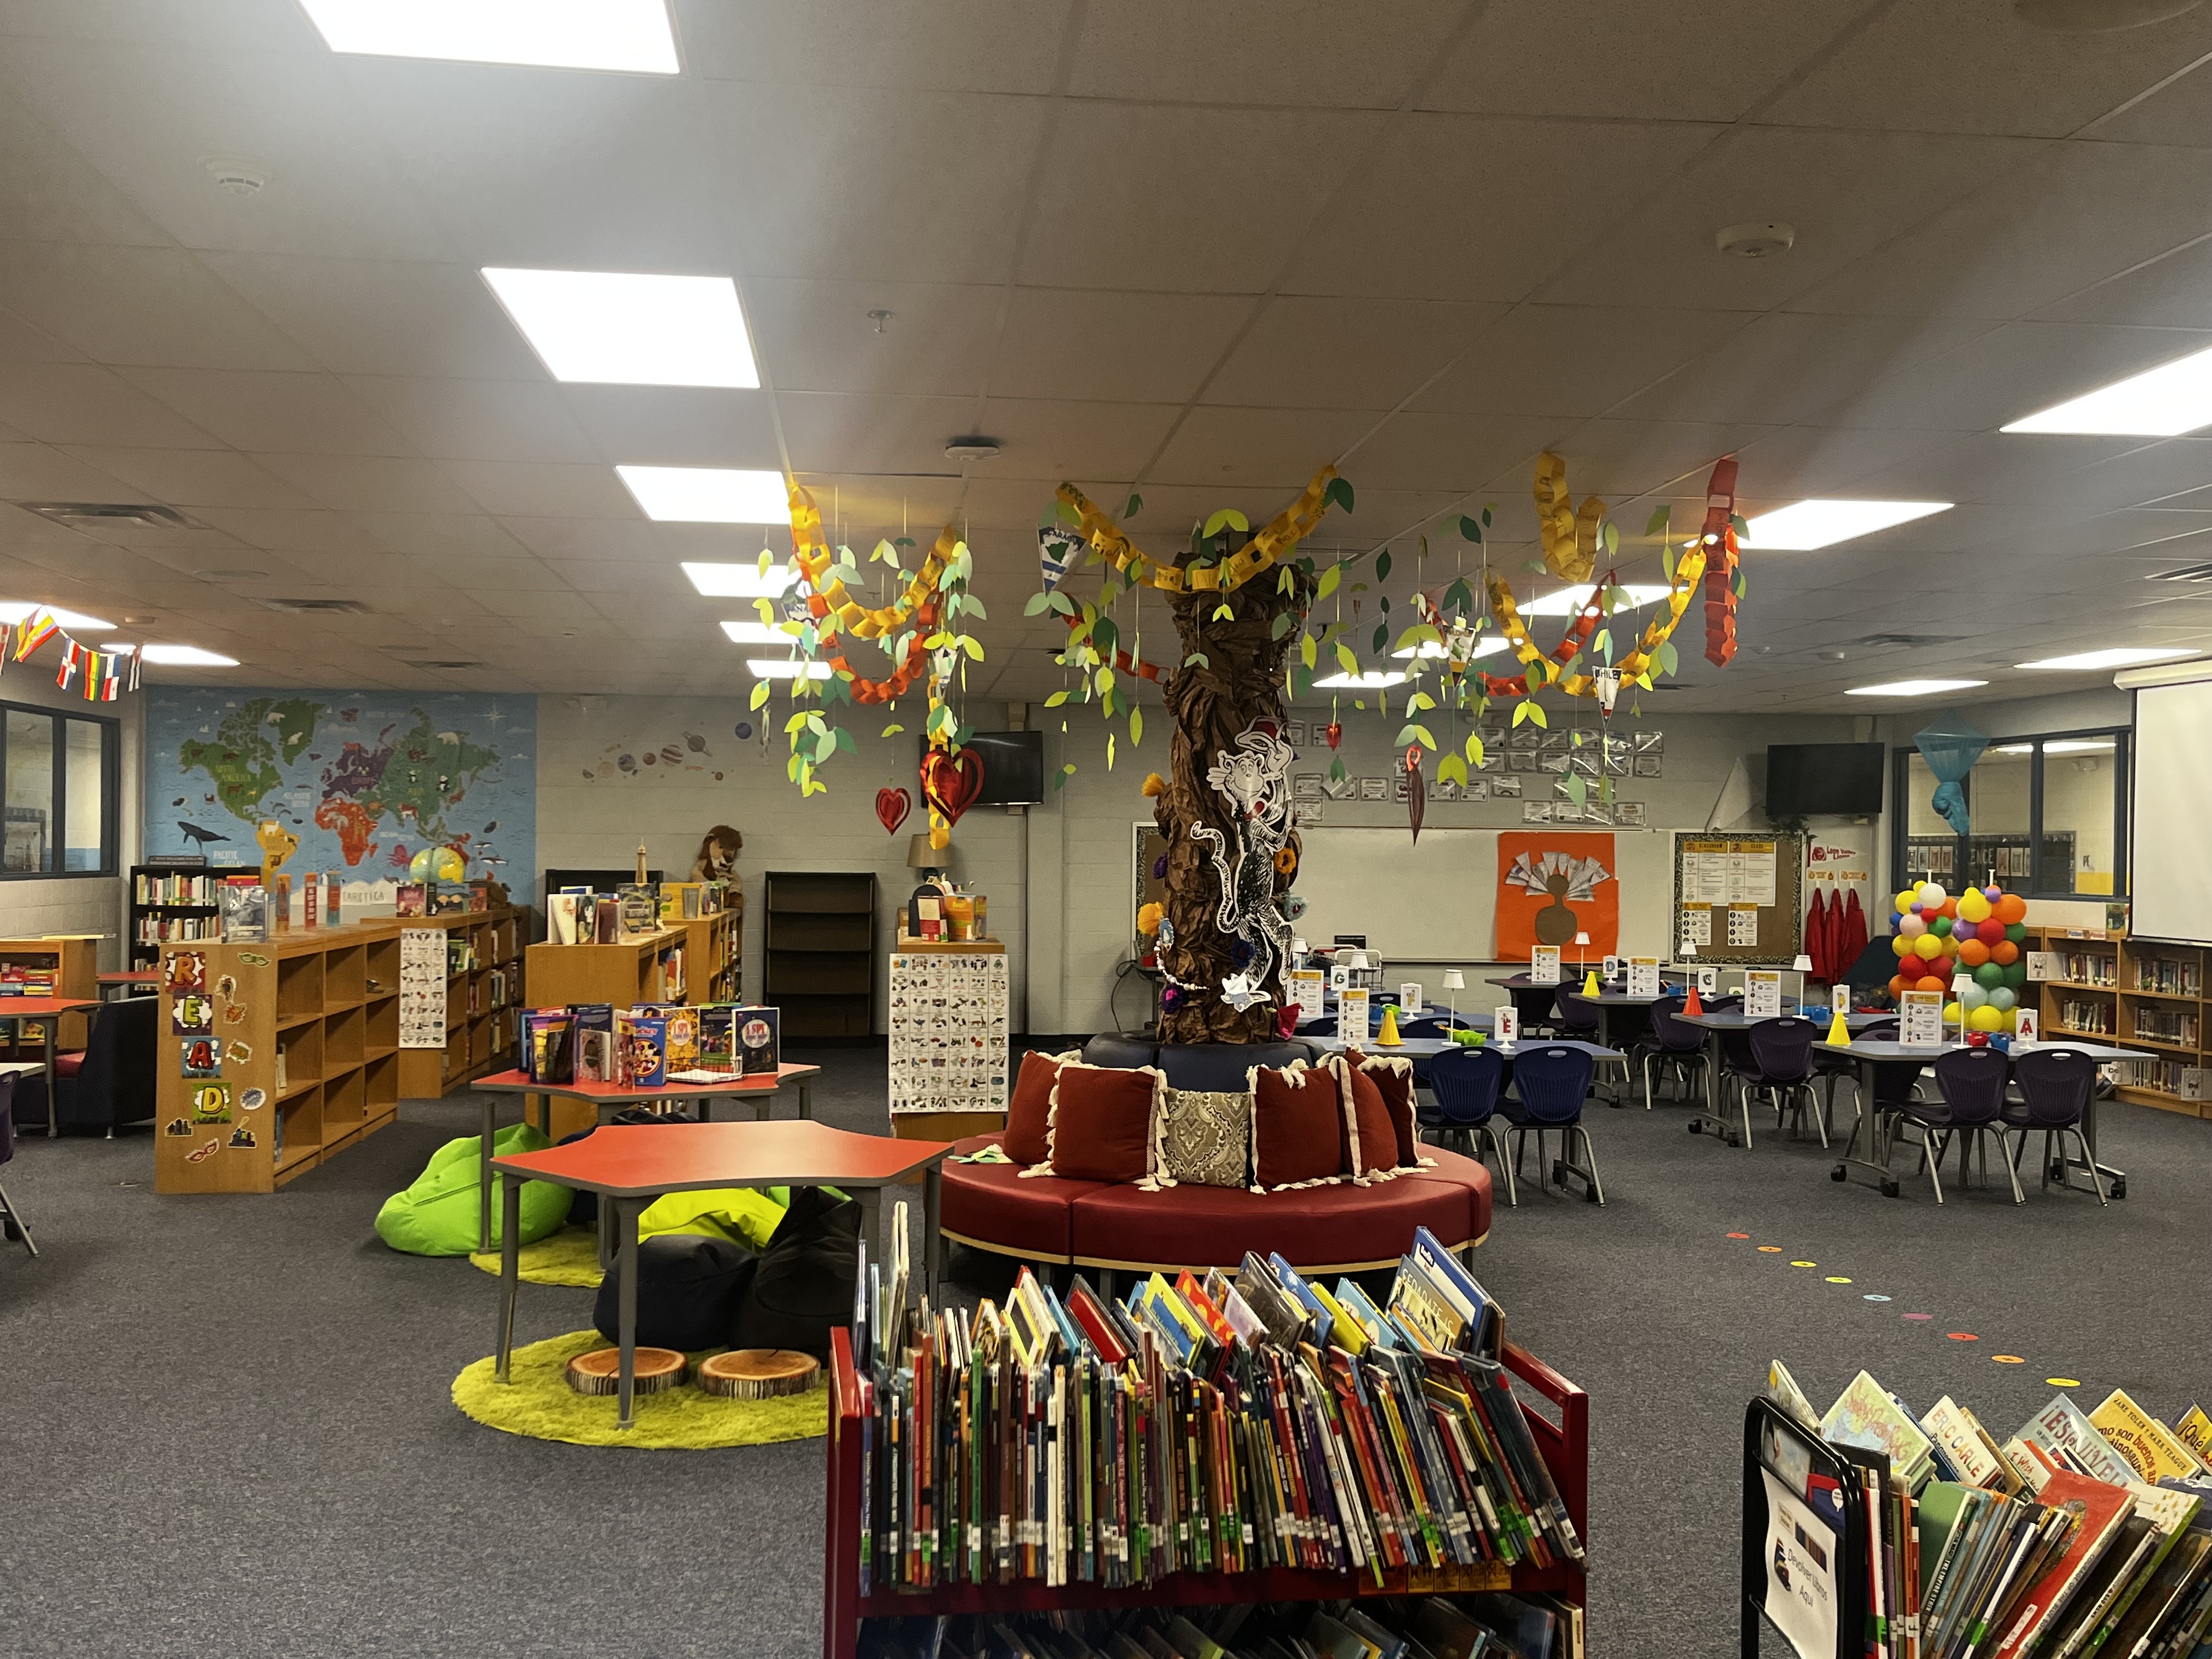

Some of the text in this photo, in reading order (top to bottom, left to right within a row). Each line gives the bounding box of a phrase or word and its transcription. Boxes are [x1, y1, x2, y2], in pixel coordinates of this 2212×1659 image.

[342, 891, 385, 903] TARCTICA
[1335, 974, 1345, 984] G
[1503, 1019, 1511, 1033] E
[1932, 1407, 1984, 1479] ERIC CARLE
[2113, 1398, 2129, 1413] JANE
[2128, 1412, 2146, 1430] YOLEN
[2148, 1432, 2165, 1450] MARK
[2164, 1448, 2188, 1471] TEAGUE
[2178, 1421, 2207, 1451] ¡Qué
[2116, 1429, 2135, 1441] son
[2132, 1434, 2156, 1469] buenos
[2016, 1454, 2034, 1474] Wish
[1788, 1548, 1828, 1601] Devolver Libros
[1940, 1559, 1951, 1571] THE
[1923, 1593, 1938, 1612] STRIK
